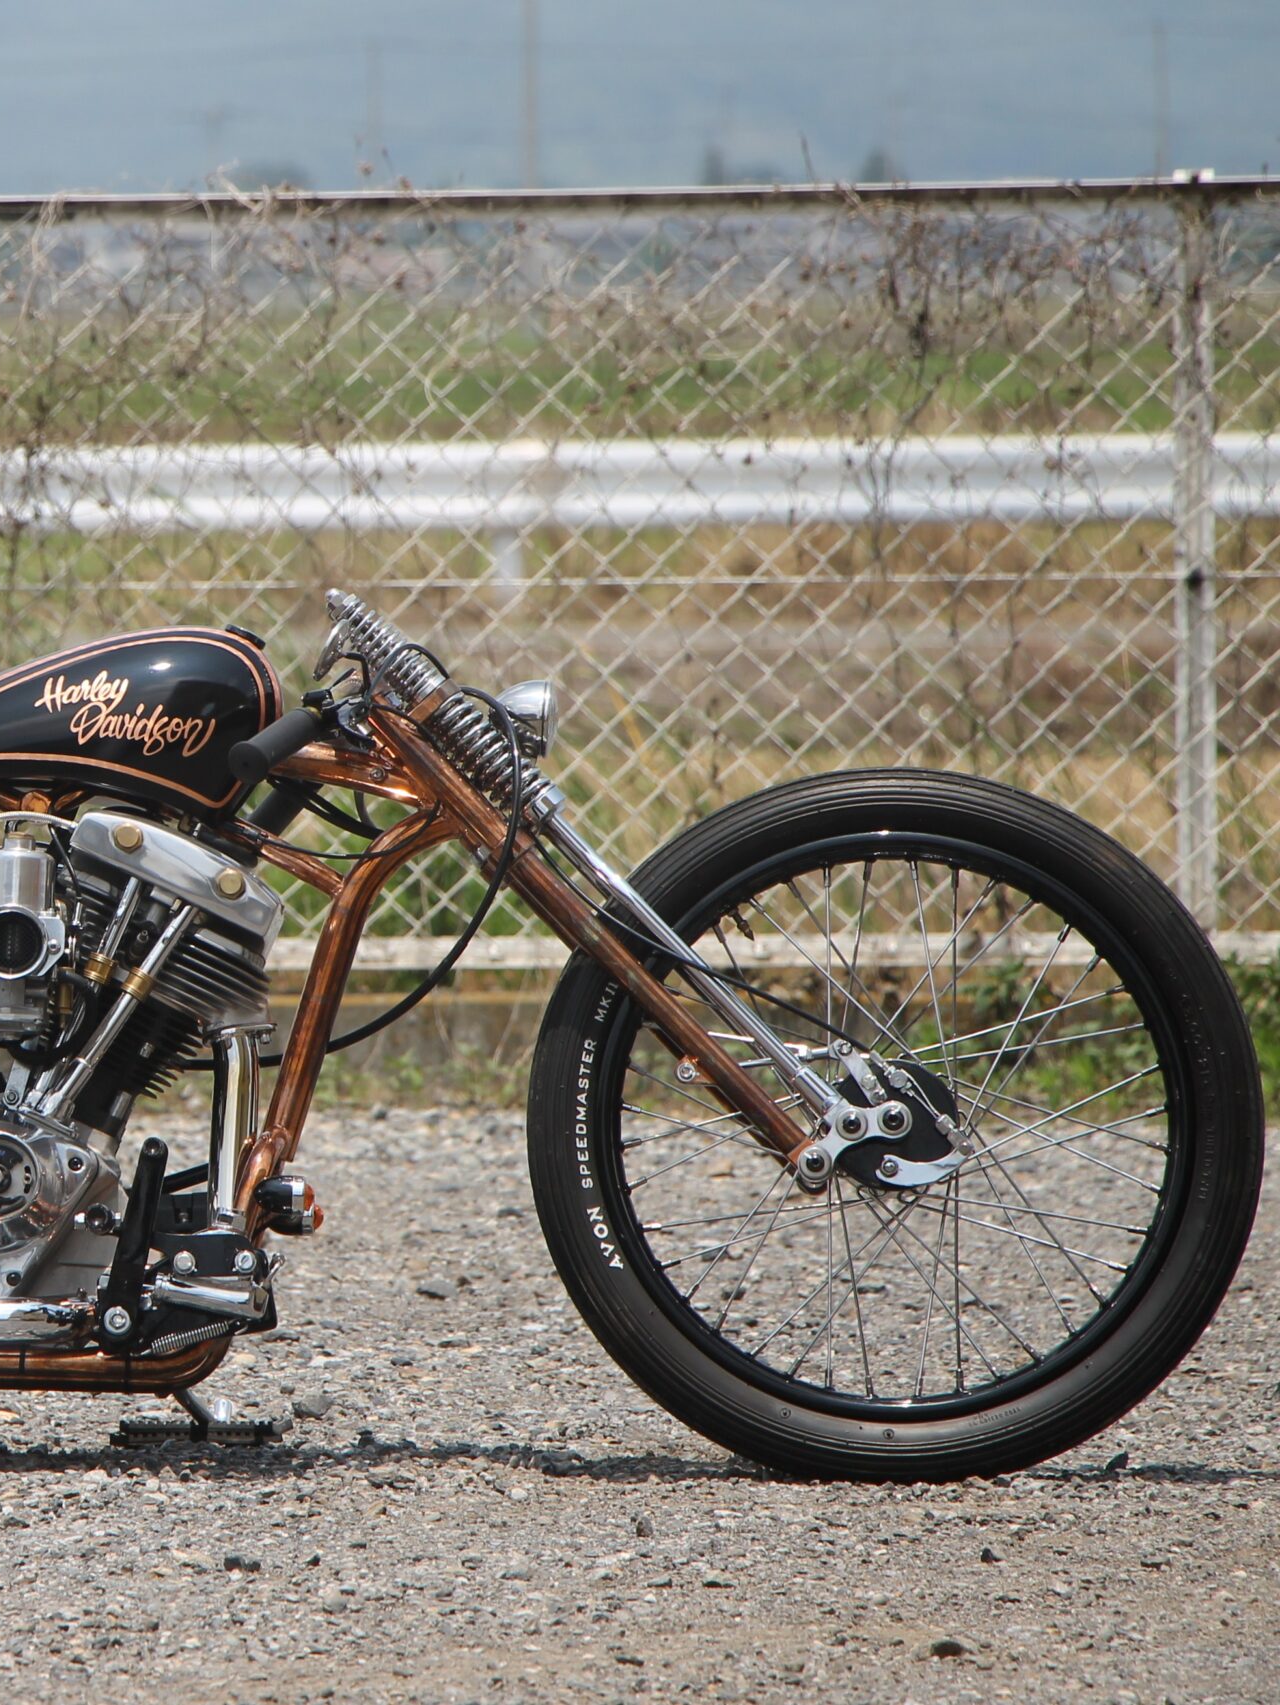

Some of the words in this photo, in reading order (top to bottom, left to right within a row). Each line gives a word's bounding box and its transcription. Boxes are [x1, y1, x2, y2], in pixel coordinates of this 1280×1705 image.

[34, 670, 129, 715] Harley
[70, 702, 216, 757] Davidson
[575, 1038, 598, 1189] SPEEDMASTER
[586, 1205, 624, 1270] AVON
